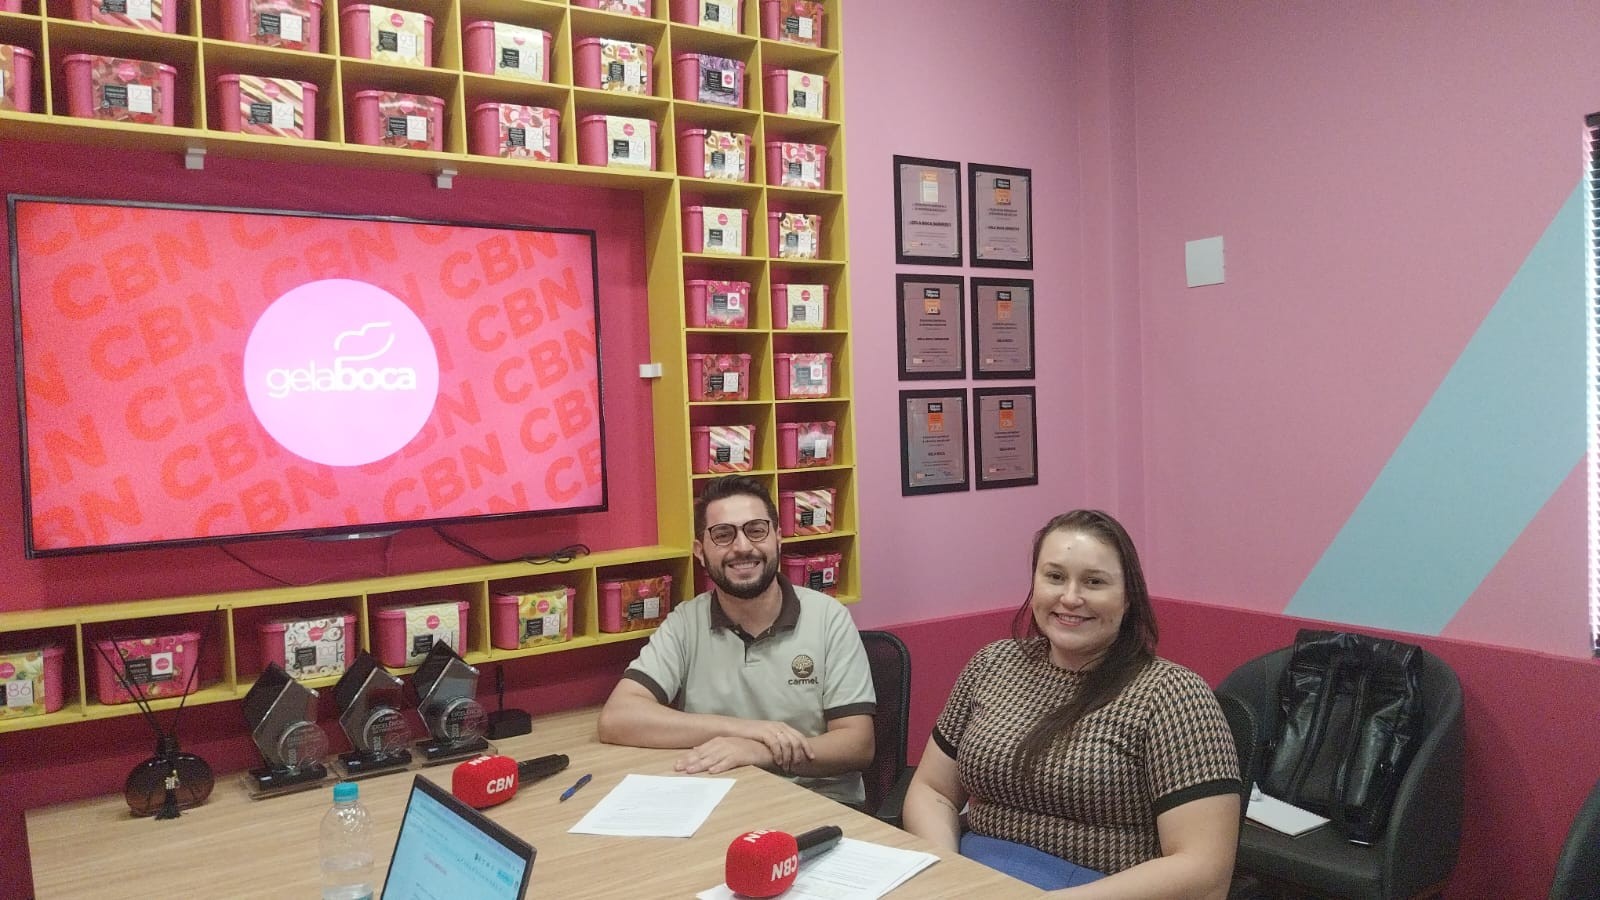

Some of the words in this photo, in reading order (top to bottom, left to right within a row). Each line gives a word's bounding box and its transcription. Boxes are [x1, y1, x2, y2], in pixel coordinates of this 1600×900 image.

[17, 202, 147, 256] CB
[53, 219, 213, 321] CBN
[439, 230, 559, 299] CBN
[90, 279, 247, 381] CBN
[467, 267, 583, 352] CBN
[266, 357, 417, 399] gelaboca
[494, 318, 598, 404] CBN
[519, 380, 600, 454] CB
[160, 424, 281, 501] CB
[383, 431, 508, 521] CBN
[195, 466, 340, 536] CBN
[8, 682, 32, 698] 86
[788, 676, 819, 686] carmel
[487, 774, 515, 794] CBN
[770, 854, 798, 882] CBN
